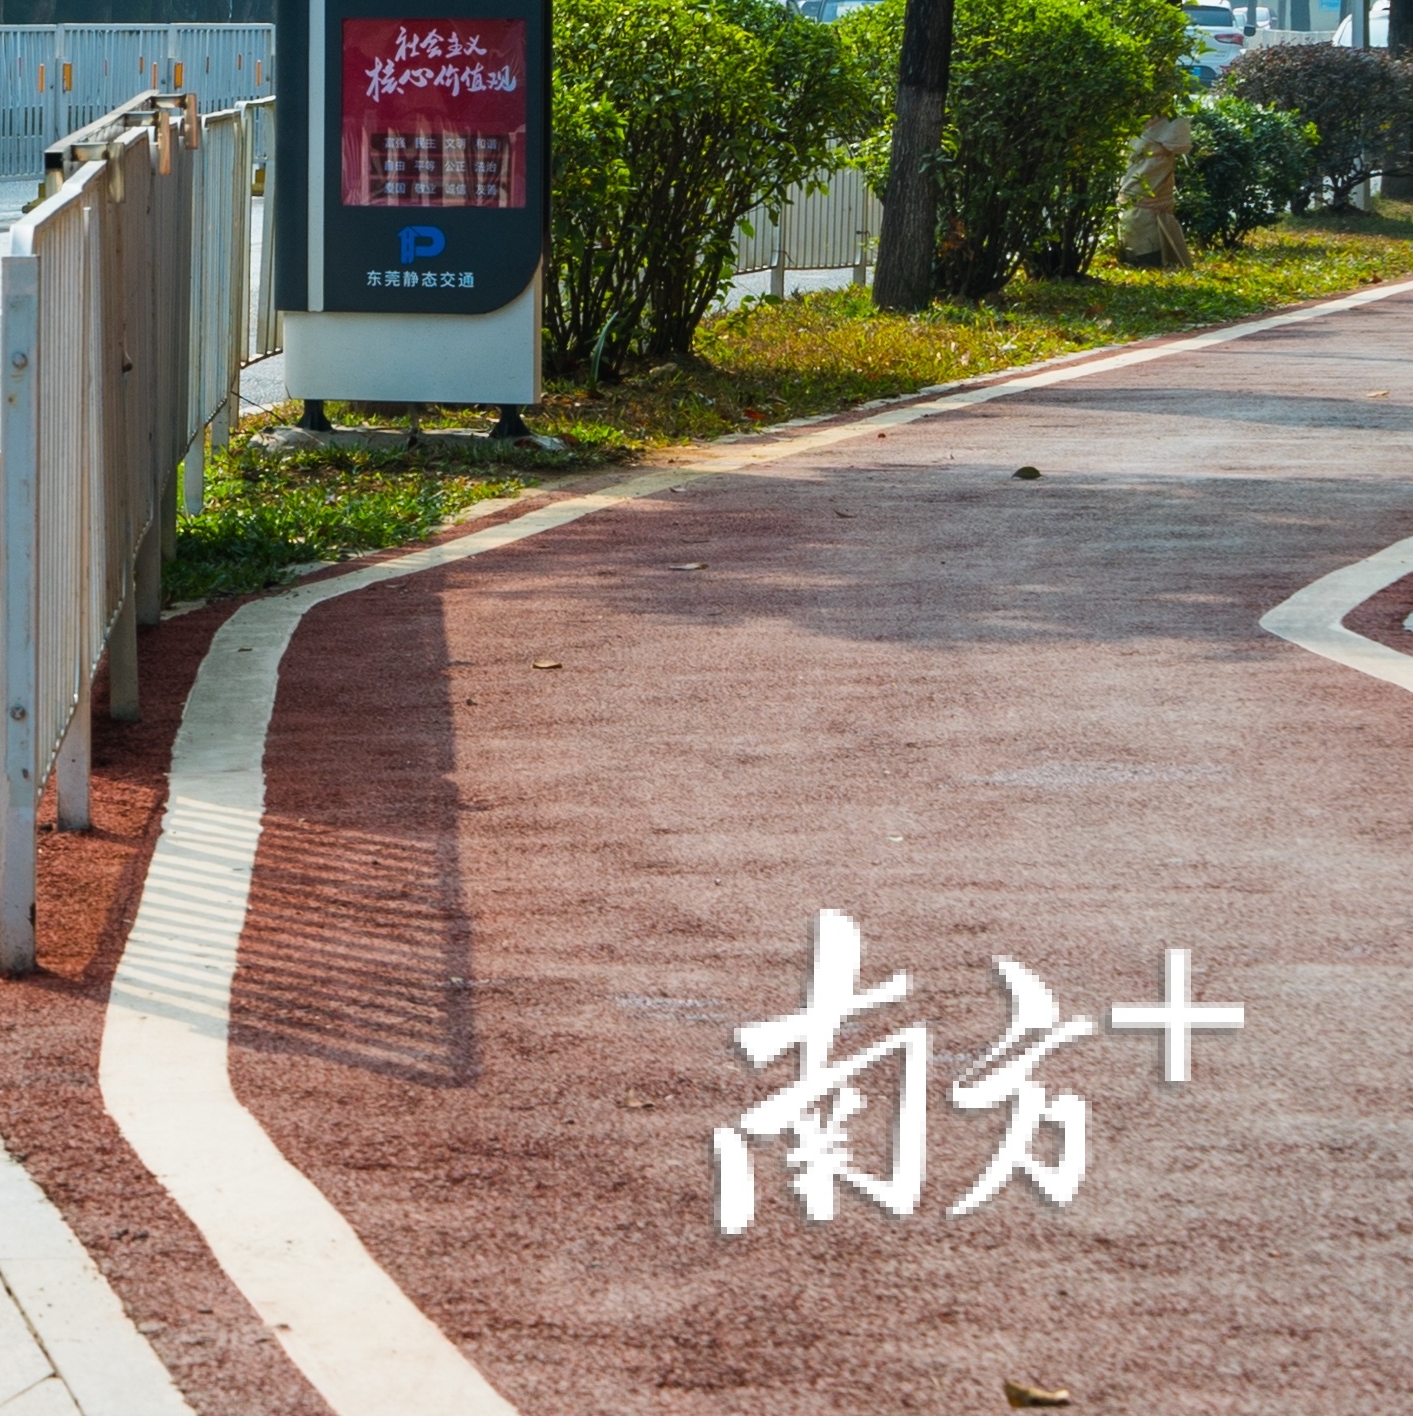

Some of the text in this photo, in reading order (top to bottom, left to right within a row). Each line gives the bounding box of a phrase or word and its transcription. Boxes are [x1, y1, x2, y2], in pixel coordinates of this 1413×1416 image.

[394, 26, 487, 62] 社会主义
[364, 56, 517, 103] 核心价值观
[445, 138, 466, 150] 文明
[444, 161, 466, 172] 公正
[475, 161, 496, 172] 法治
[366, 270, 475, 288] 东莞静态交通
